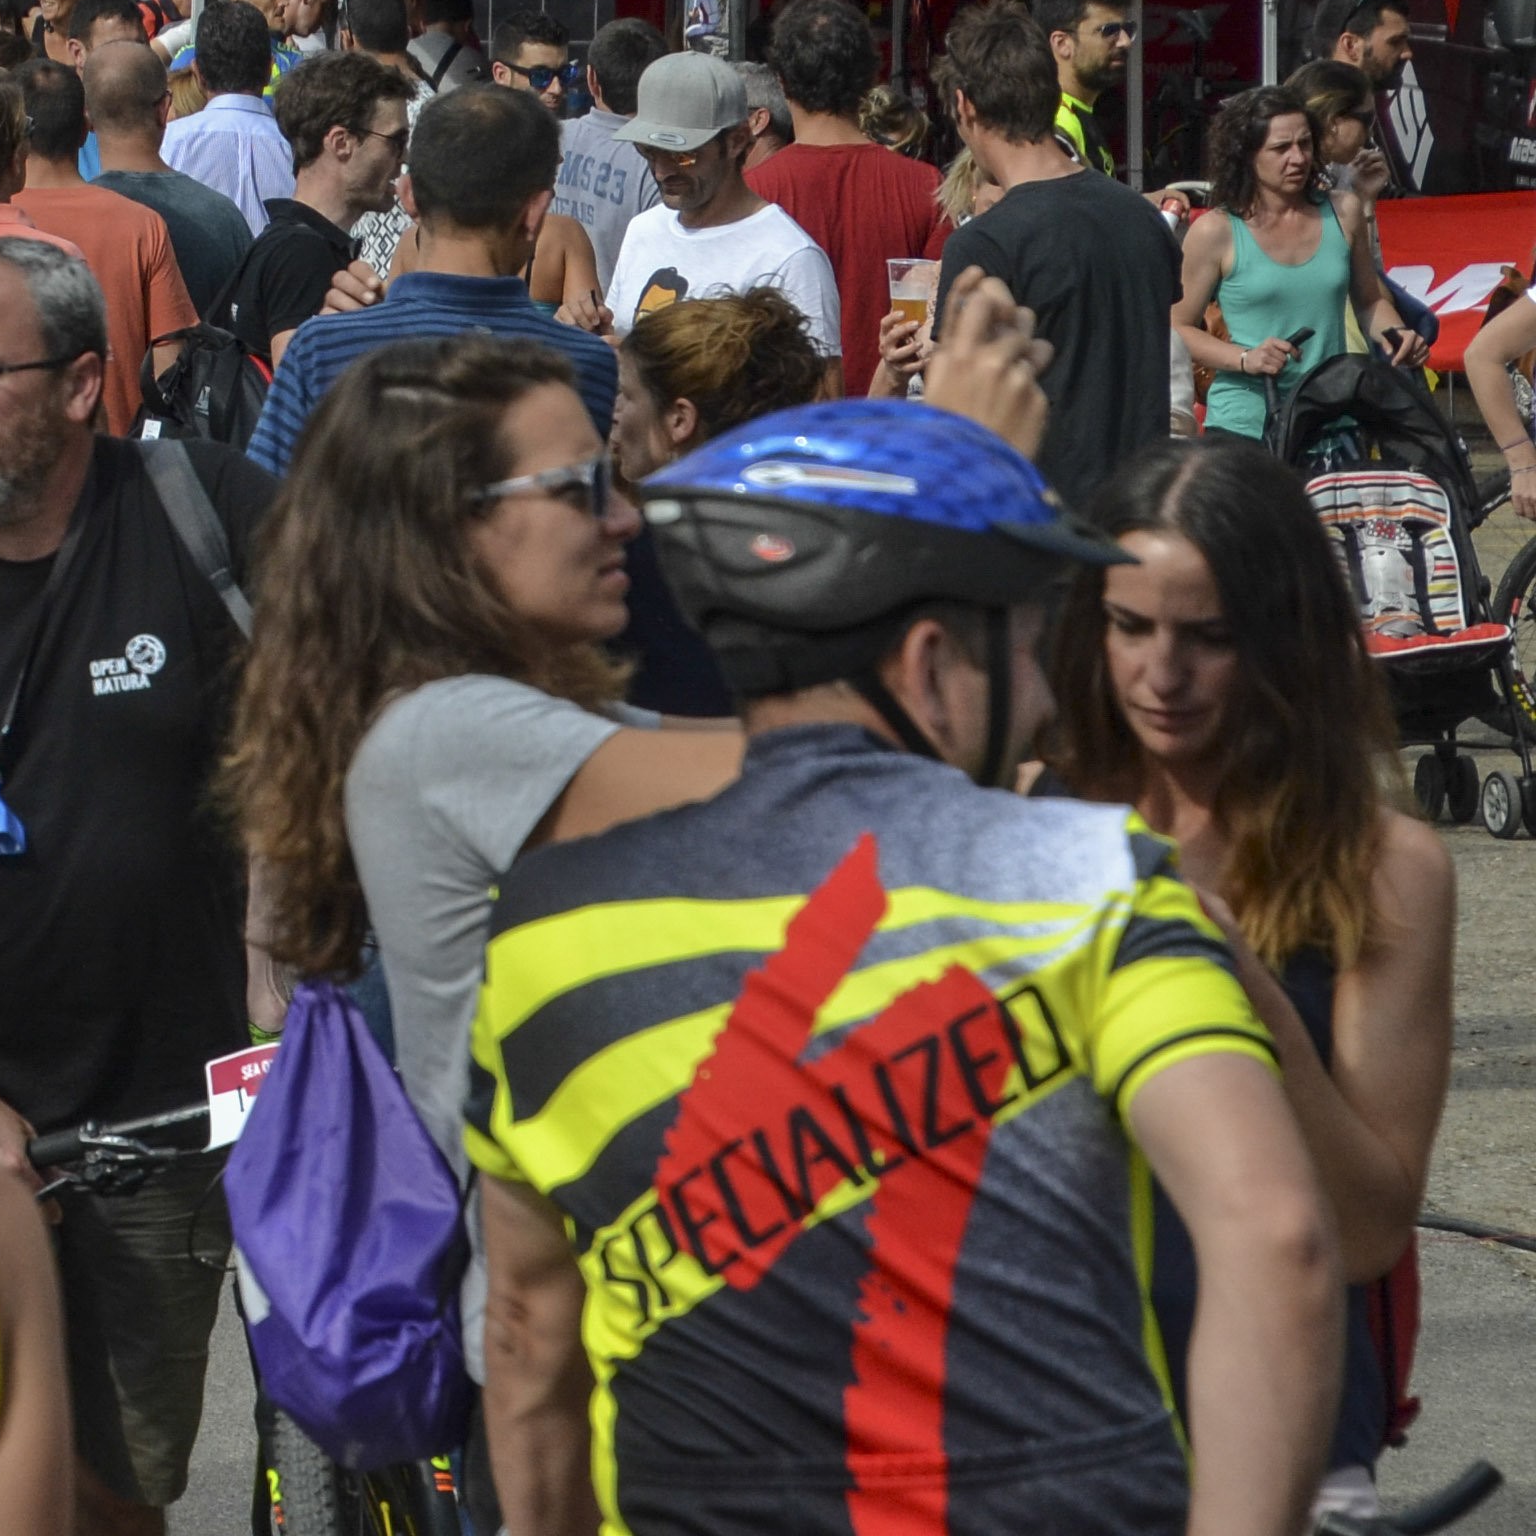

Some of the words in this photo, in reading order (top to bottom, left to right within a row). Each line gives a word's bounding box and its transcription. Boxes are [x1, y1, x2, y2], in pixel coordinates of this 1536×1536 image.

[593, 162, 627, 206] 23
[89, 657, 129, 679] OPEN
[92, 674, 151, 696] NATURA
[240, 1062, 262, 1081] SEA
[600, 982, 1074, 1328] SPECIALIZED
